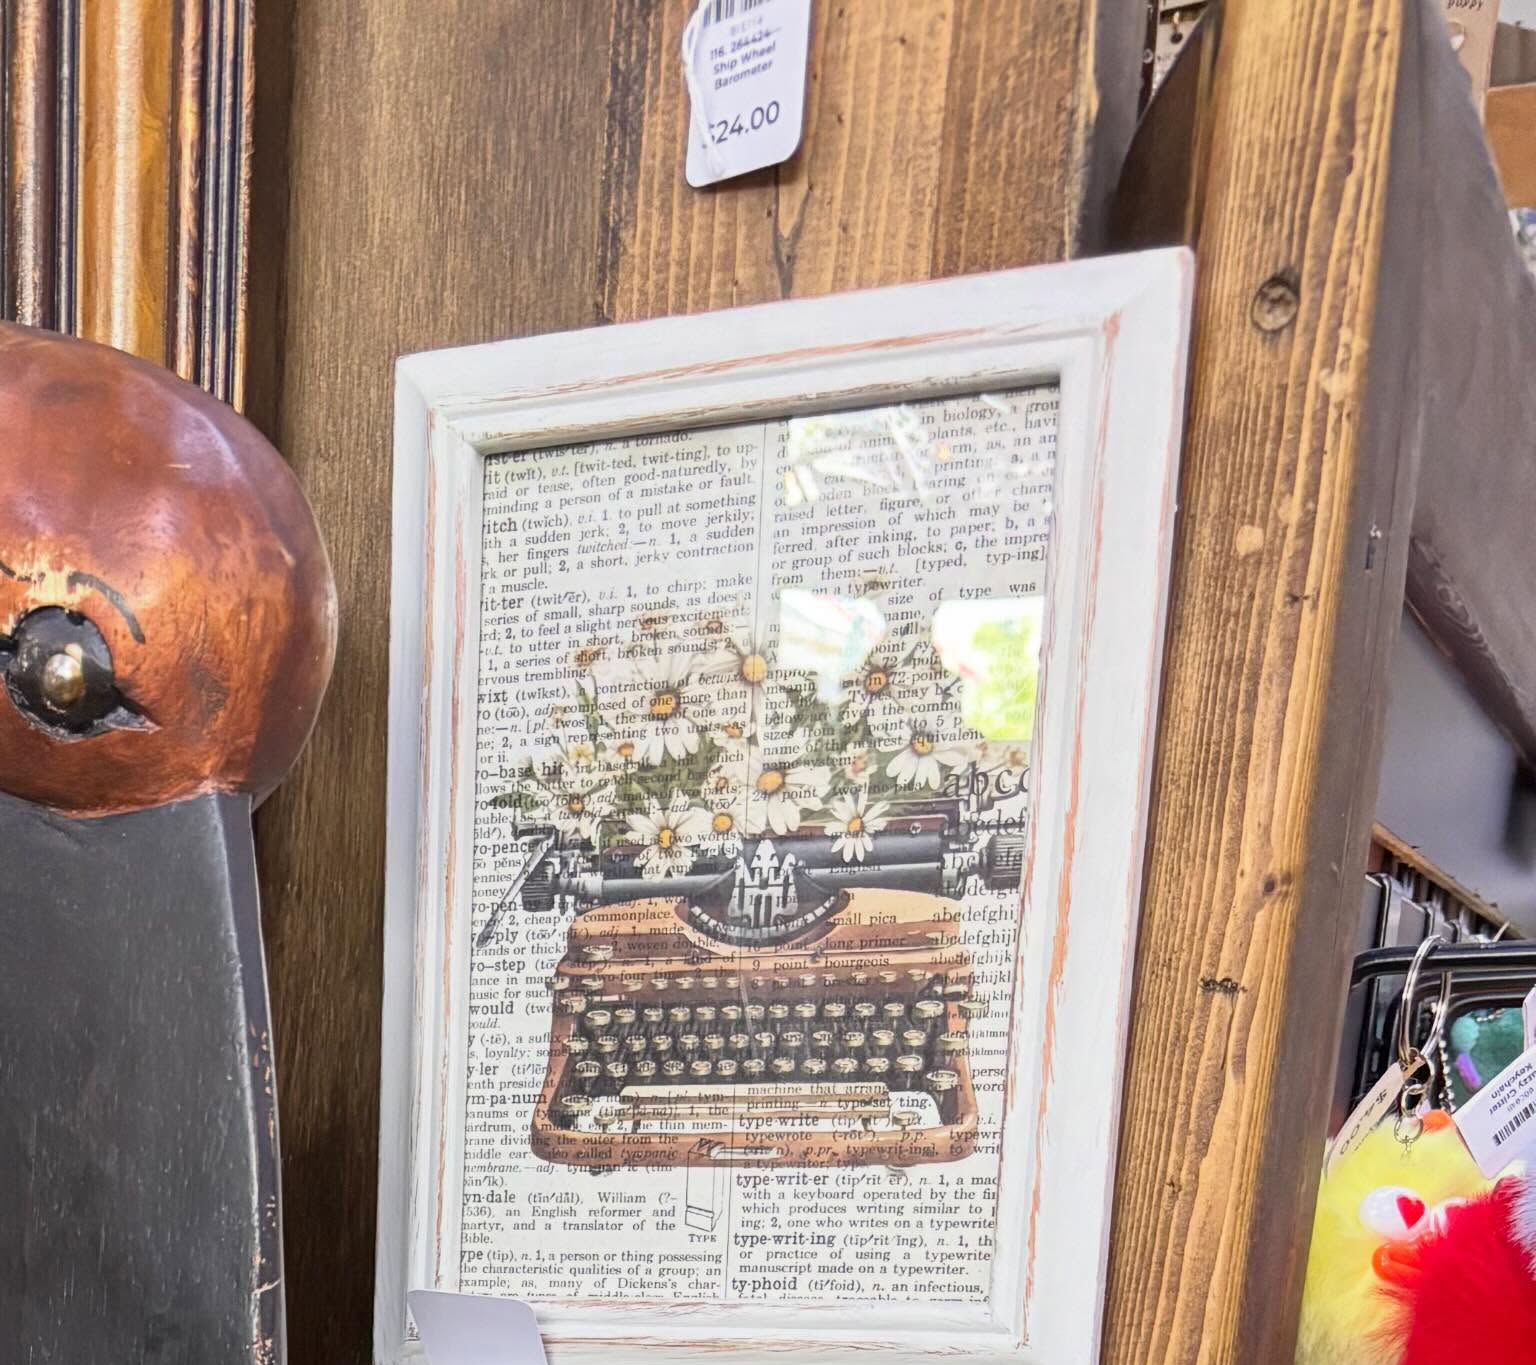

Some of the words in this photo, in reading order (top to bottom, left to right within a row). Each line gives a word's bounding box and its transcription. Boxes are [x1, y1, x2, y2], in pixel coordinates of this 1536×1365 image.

[712, 57, 738, 75] Ship
[740, 41, 777, 65] Wheel
[714, 60, 774, 91] Barometer
[618, 508, 631, 519] to
[636, 504, 661, 520] pull
[666, 502, 681, 514] at
[685, 494, 756, 512] something
[773, 528, 789, 539] an
[801, 519, 875, 536] impression
[887, 512, 903, 526] of
[913, 508, 955, 522] which
[969, 504, 1000, 517] may
[1013, 501, 1029, 512] be
[509, 537, 517, 547] a
[524, 530, 570, 545] sudden
[639, 521, 652, 532] to
[661, 517, 696, 530] move
[503, 568, 518, 577] or
[576, 560, 584, 570] a
[676, 542, 754, 559] contraction
[771, 560, 786, 569] or
[791, 555, 832, 569] group
[838, 550, 854, 563] of
[857, 547, 889, 560] such
[974, 537, 997, 548] the
[751, 960, 760, 971] 9
[772, 958, 809, 972] point
[824, 955, 890, 970] bourgeois
[742, 1188, 771, 1200] with
[777, 1191, 785, 1199] a
[793, 1187, 854, 1201] keyboard
[862, 1187, 922, 1201] operated
[929, 1188, 947, 1202] by
[953, 1188, 975, 1200] the
[741, 1202, 779, 1214] which
[788, 1201, 846, 1215] produces
[856, 1203, 904, 1216] writing
[912, 1202, 960, 1214] similar
[968, 1203, 983, 1214] to
[687, 1233, 716, 1242] TYPE
[548, 1253, 555, 1261] a
[559, 1253, 599, 1263] person
[603, 1253, 617, 1261] or
[621, 1250, 654, 1264] thing
[658, 1253, 723, 1264] possessing
[739, 1262, 812, 1275] manuscript
[817, 1262, 854, 1273] made
[857, 1265, 874, 1273] on
[879, 1265, 887, 1274] a
[893, 1263, 968, 1277] typewriter.
